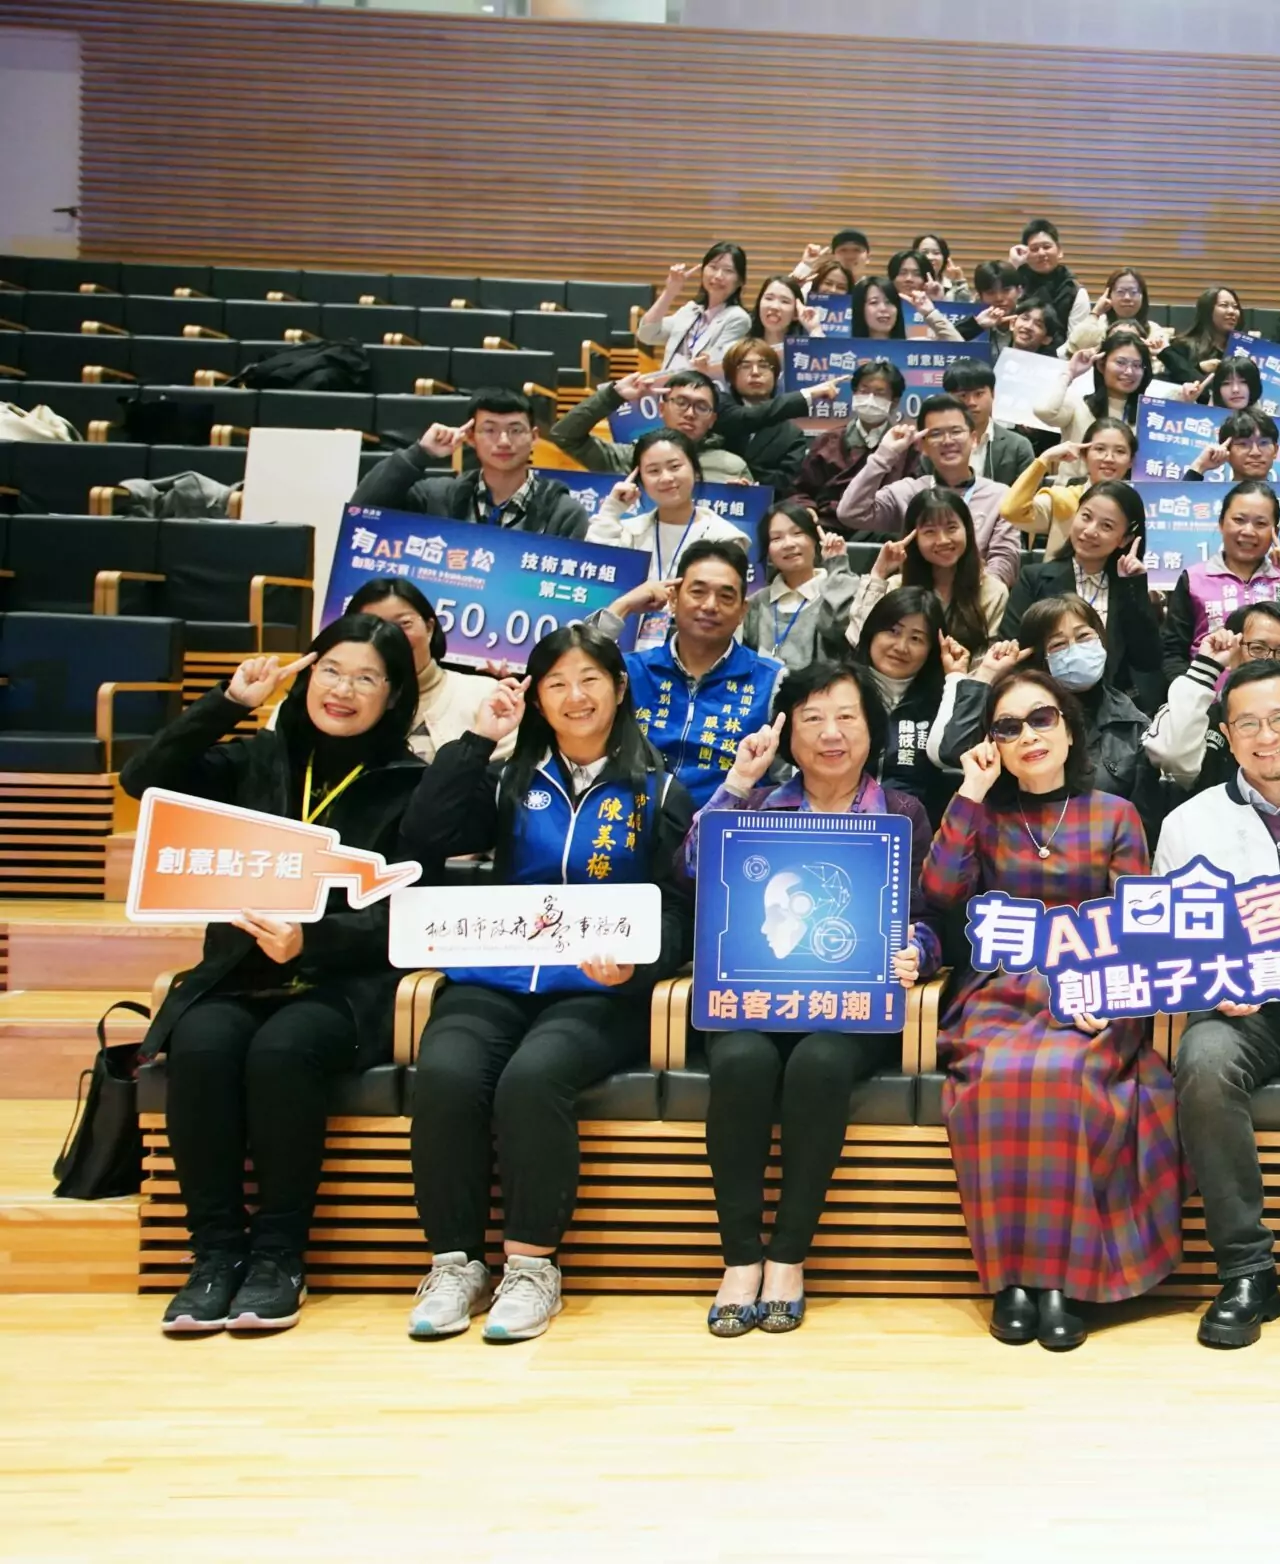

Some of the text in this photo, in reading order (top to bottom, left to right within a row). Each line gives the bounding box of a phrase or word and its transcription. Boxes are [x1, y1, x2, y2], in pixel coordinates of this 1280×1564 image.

[808, 401, 848, 417] 台幣
[519, 551, 618, 583] 技術實作組
[1144, 550, 1183, 570] 台幣
[538, 579, 589, 604] 第二名
[586, 797, 623, 880] 陳美梅
[156, 846, 304, 879] 創意點子組
